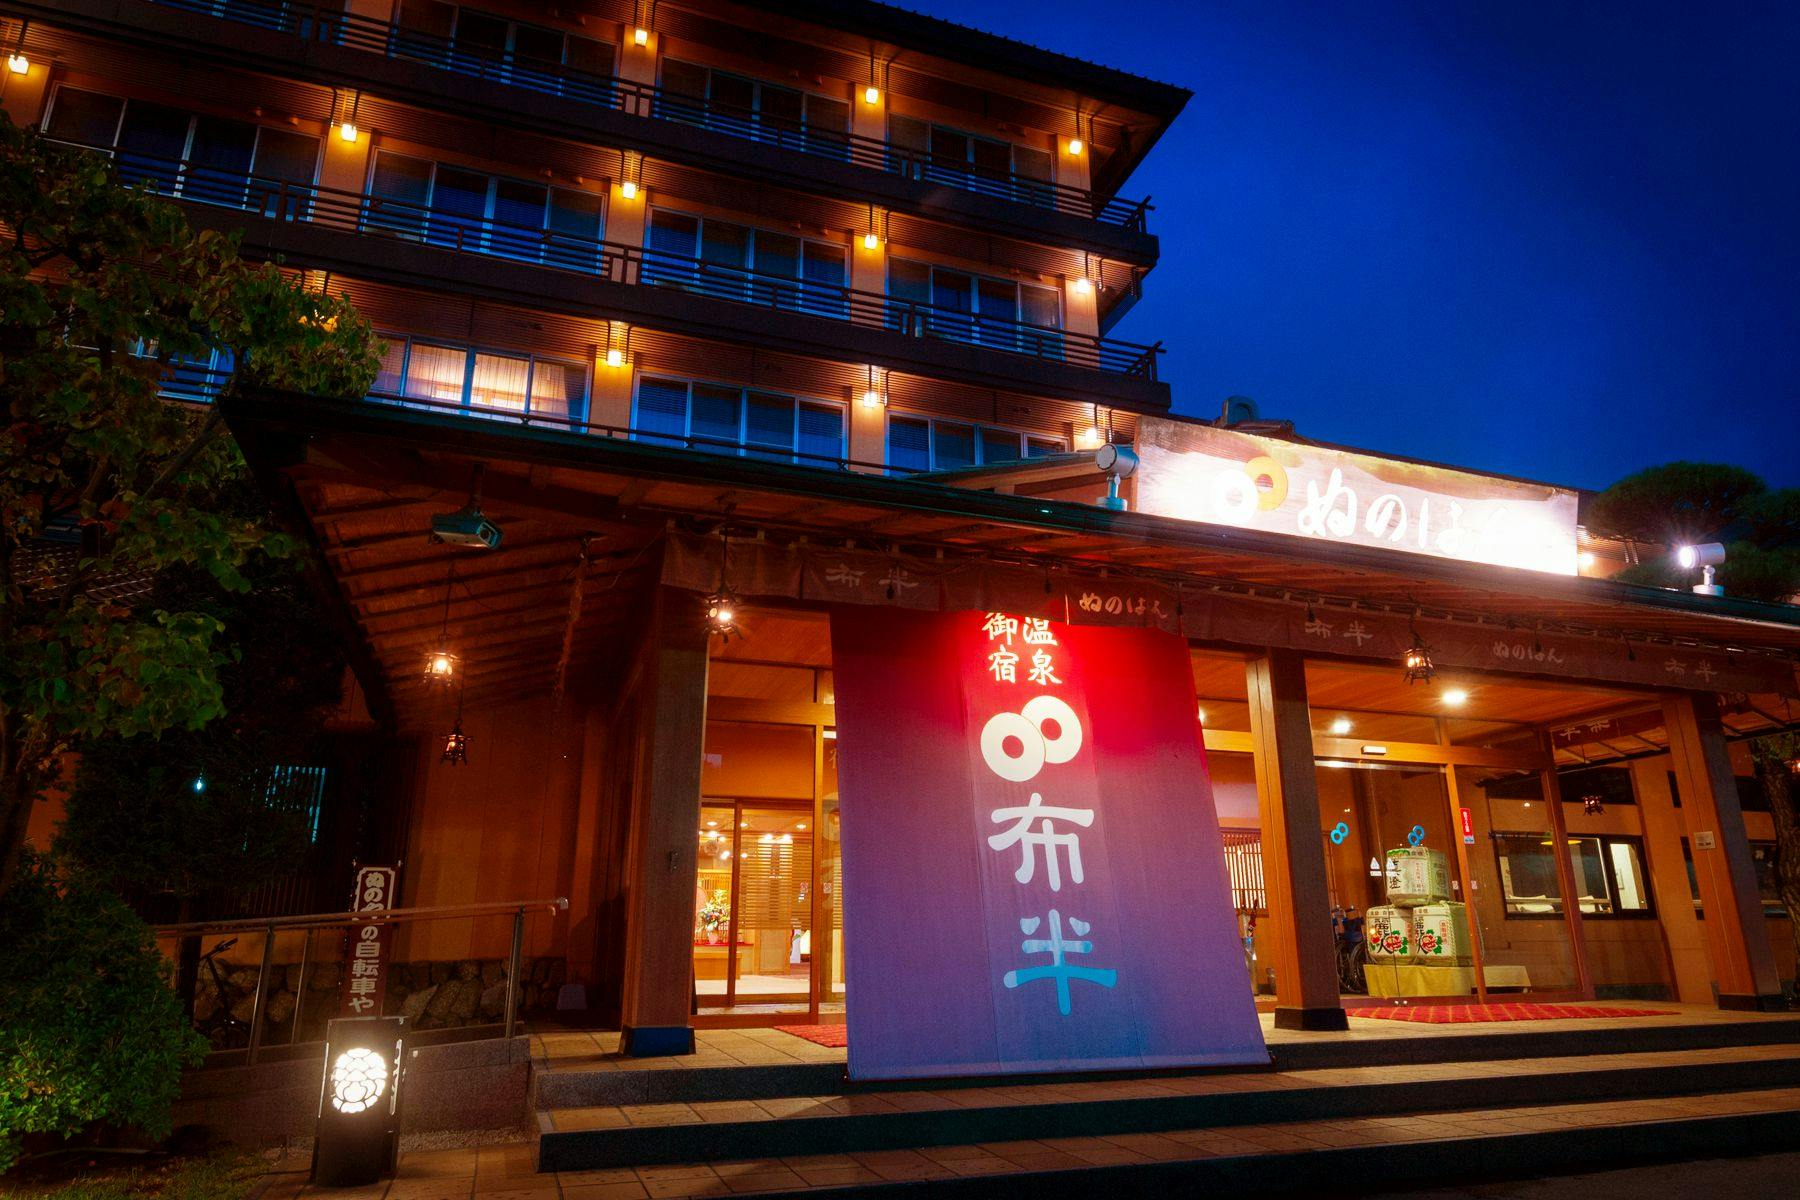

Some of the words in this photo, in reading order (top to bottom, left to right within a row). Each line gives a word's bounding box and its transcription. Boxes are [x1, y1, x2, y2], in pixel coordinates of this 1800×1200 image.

[1297, 467, 1535, 562] ぬのは
[1079, 592, 1168, 619] ぬのはん
[981, 612, 1020, 684] 御宿
[1022, 616, 1063, 686] 温泉
[987, 792, 1118, 1017] 布半
